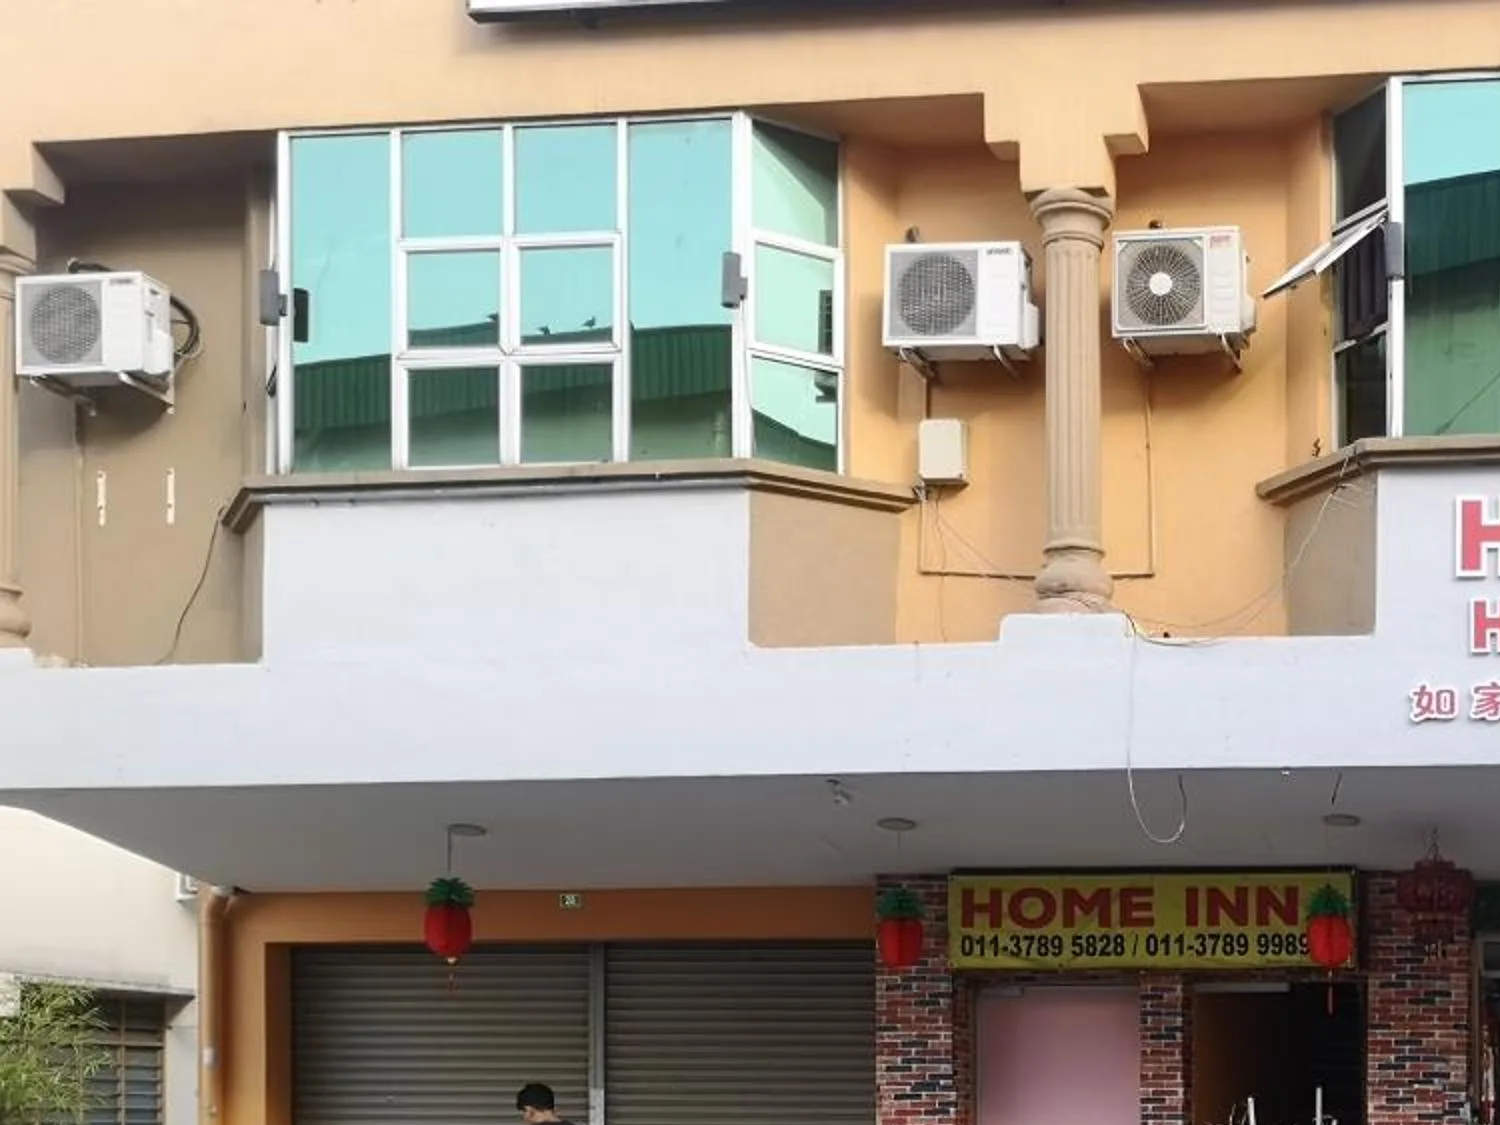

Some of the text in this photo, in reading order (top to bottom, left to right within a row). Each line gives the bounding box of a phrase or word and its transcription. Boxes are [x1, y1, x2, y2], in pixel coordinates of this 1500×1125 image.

[961, 887, 1299, 928] HOME INN
[960, 932, 1310, 958] 011-3789 5828 / 011-3789 9989
